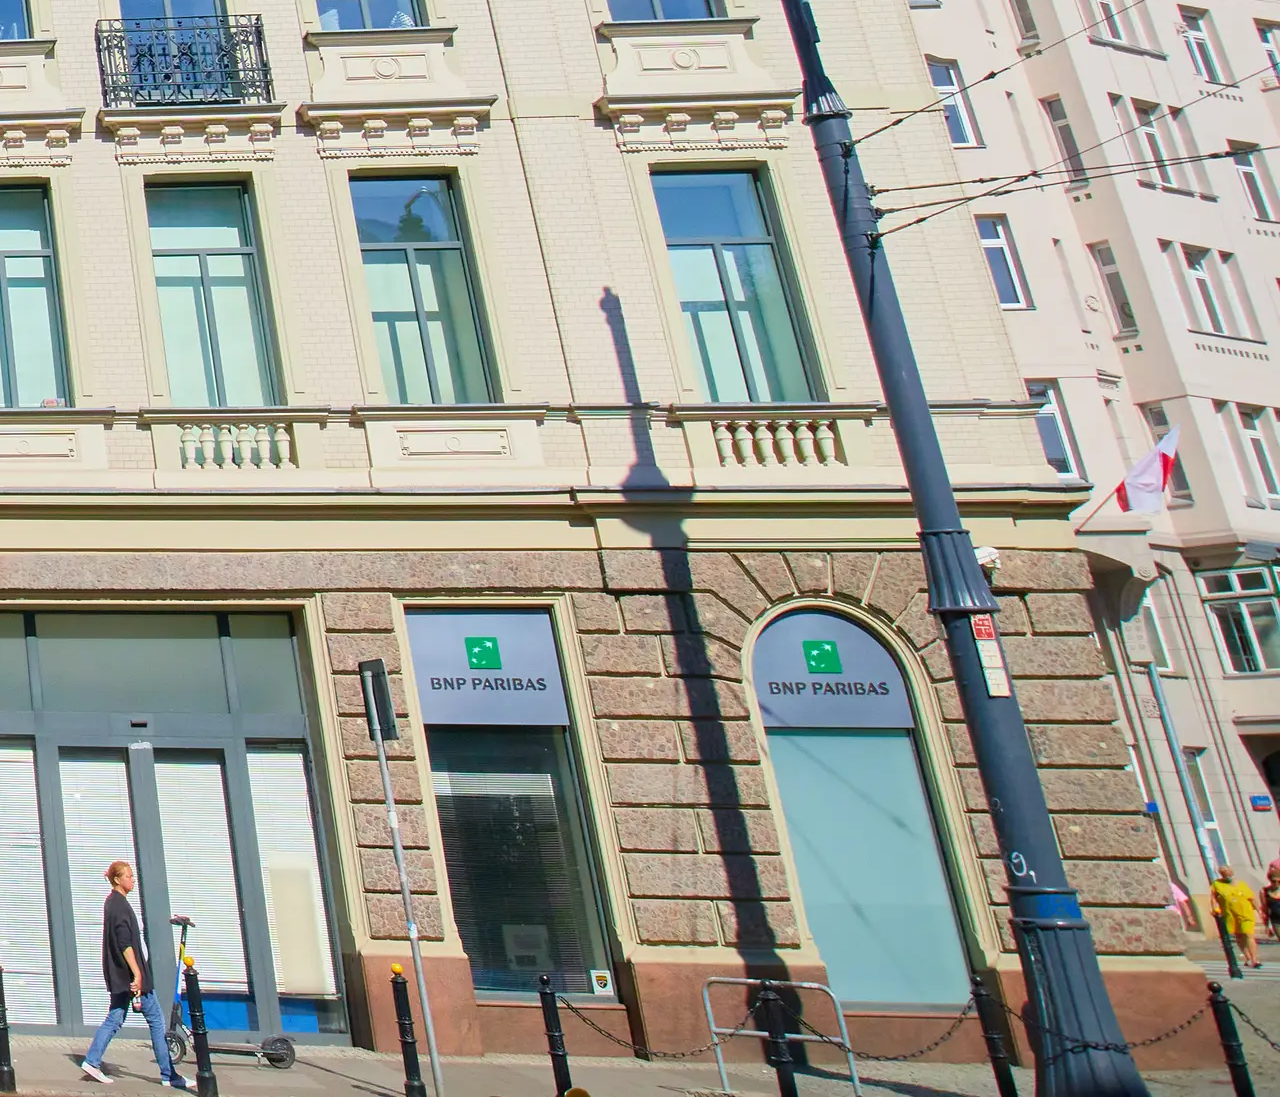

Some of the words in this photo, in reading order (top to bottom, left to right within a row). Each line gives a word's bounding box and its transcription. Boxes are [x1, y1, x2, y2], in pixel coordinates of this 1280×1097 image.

[430, 677, 467, 690] BNP
[472, 677, 547, 691] PARIBAS
[768, 682, 806, 695] BNP
[811, 682, 890, 695] PARIBAS
